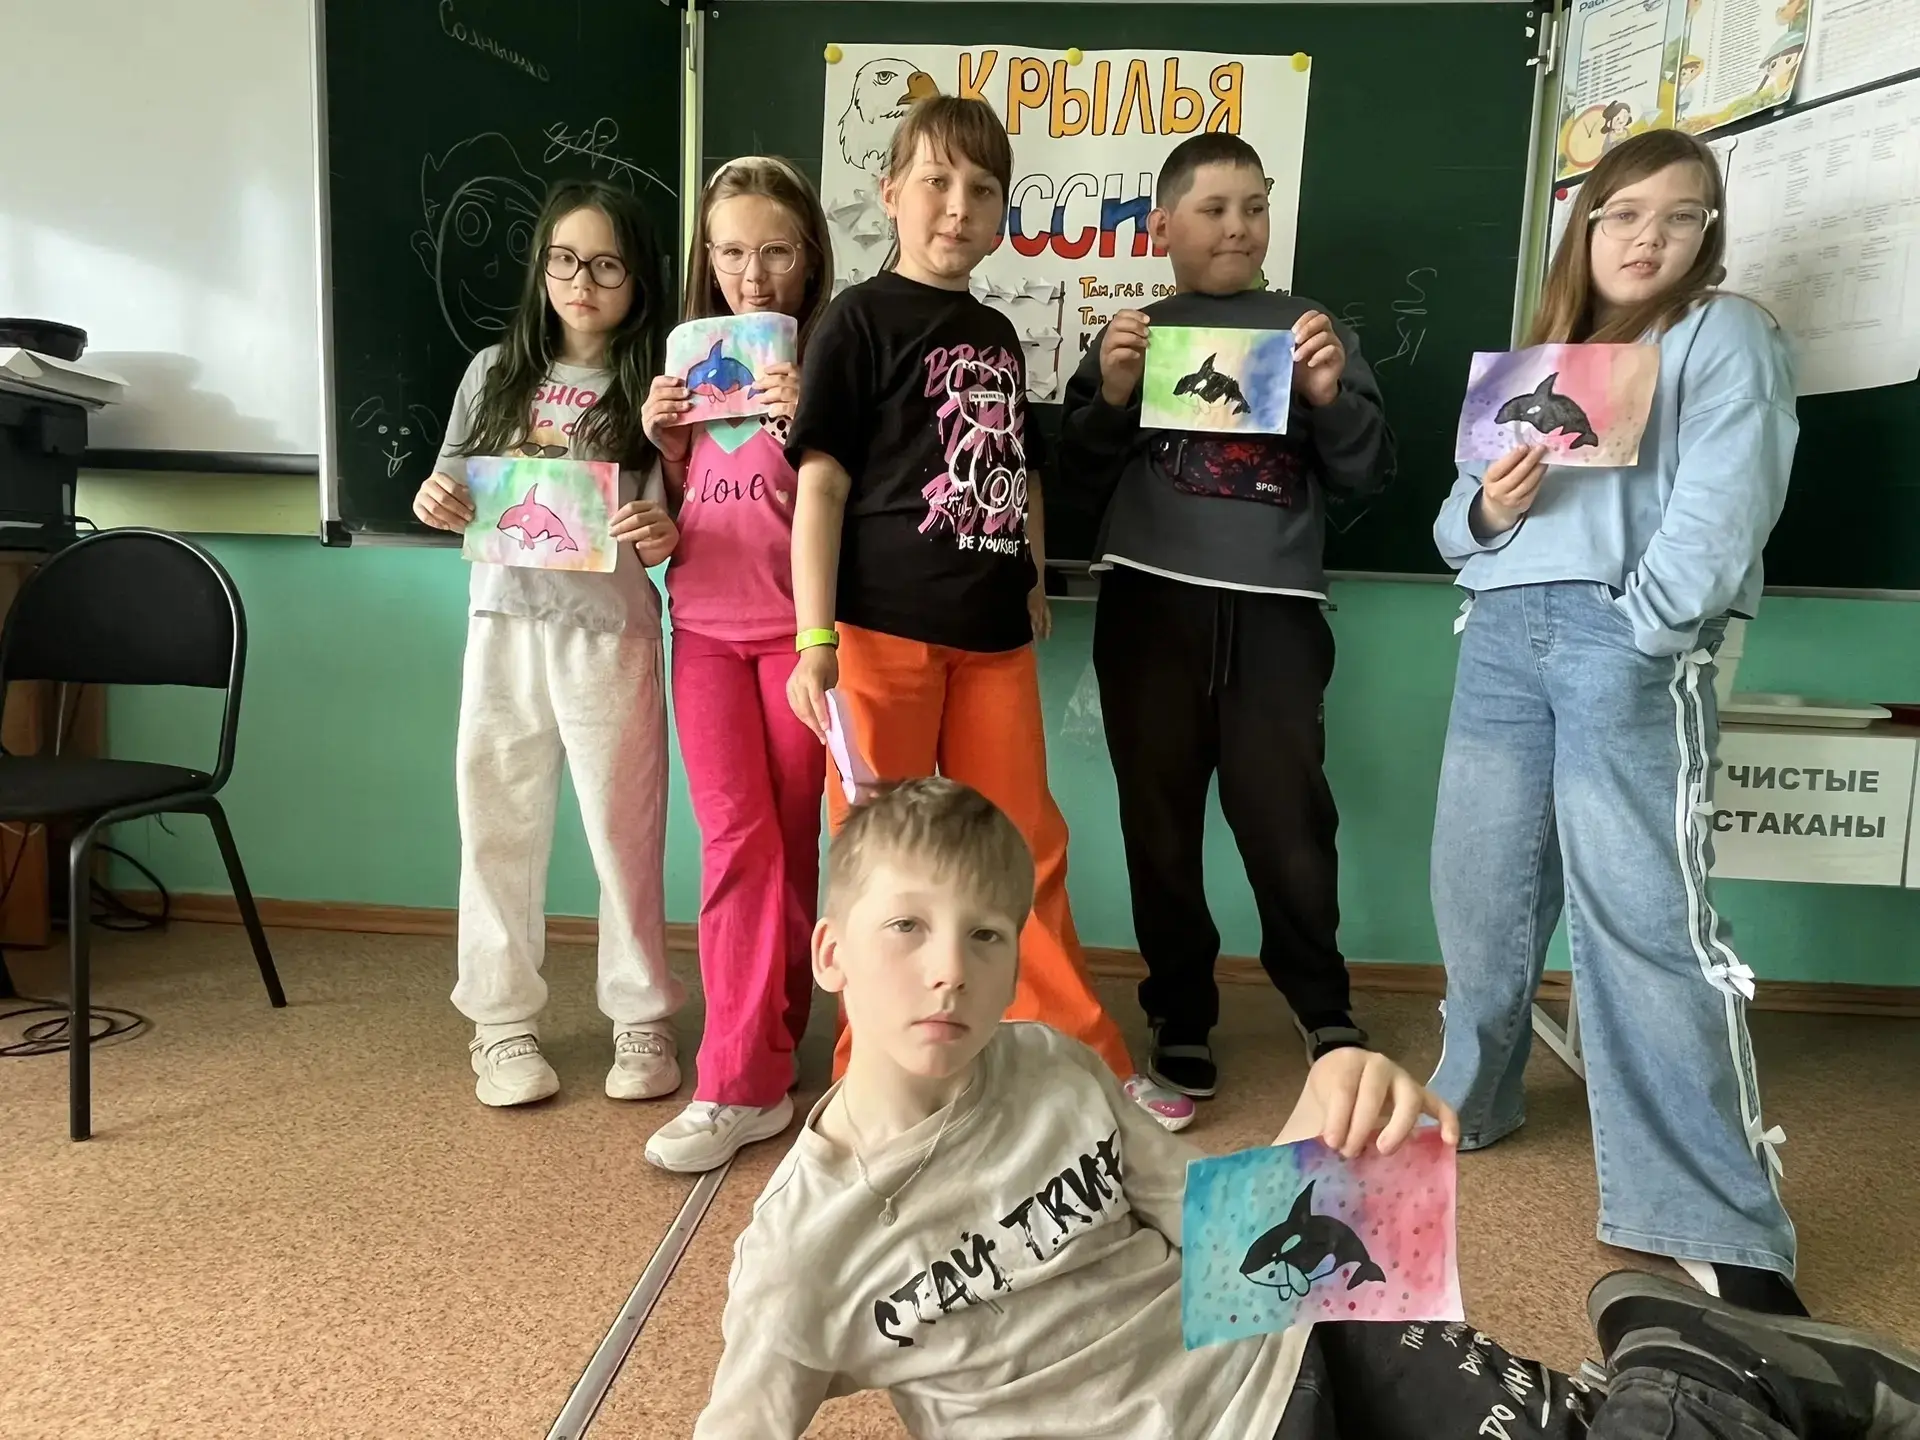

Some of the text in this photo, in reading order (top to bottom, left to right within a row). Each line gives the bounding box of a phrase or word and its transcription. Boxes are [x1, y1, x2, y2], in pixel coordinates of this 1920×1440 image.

[958, 50, 1244, 138] КРЫЛЬЯ
[1255, 482, 1282, 495] SPORT
[958, 533, 975, 550] BE
[1727, 765, 1880, 793] ЧИСТЫЕ
[1713, 809, 1886, 838] СТАКАНЫ
